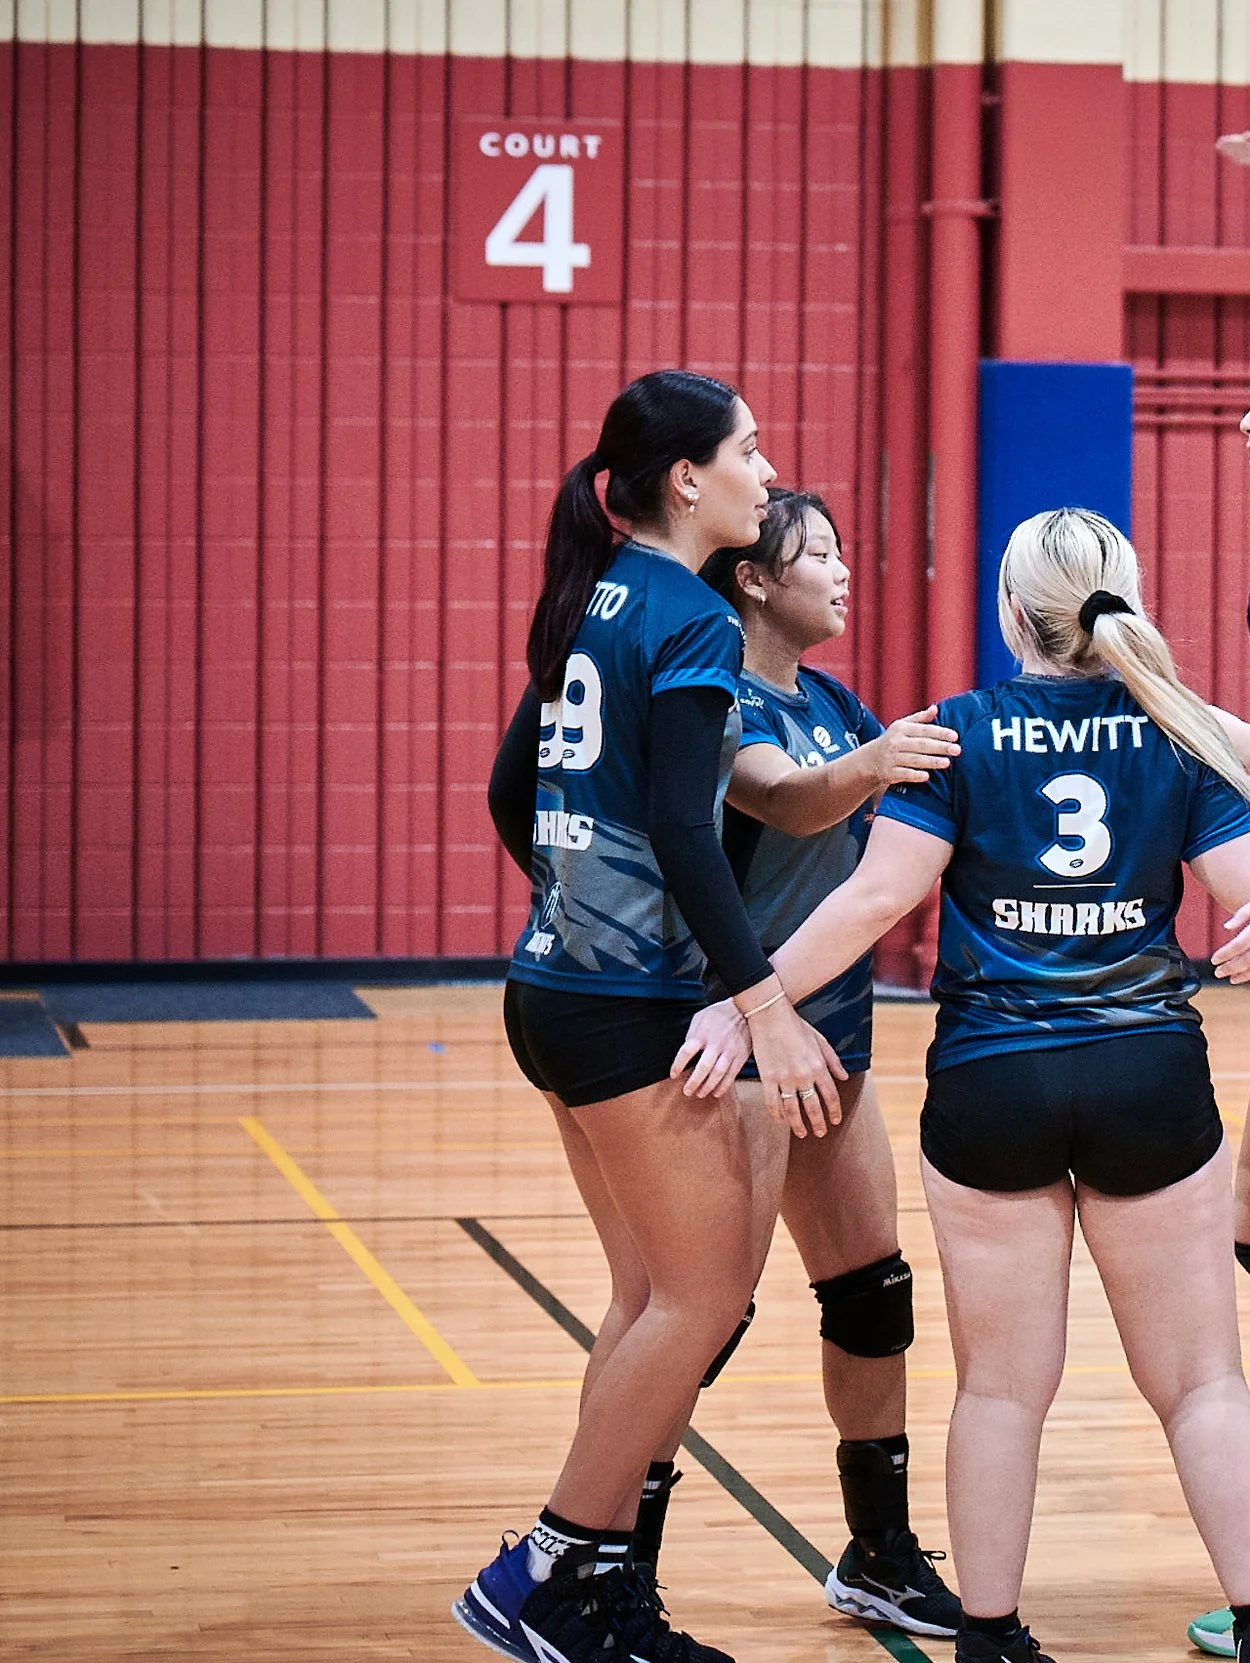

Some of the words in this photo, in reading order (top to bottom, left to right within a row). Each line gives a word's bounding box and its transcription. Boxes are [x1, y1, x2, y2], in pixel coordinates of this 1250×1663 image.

[479, 131, 602, 159] COURT
[485, 163, 592, 292] 4
[991, 714, 1149, 753] HEWITT
[1038, 773, 1113, 878] 3
[992, 898, 1147, 936] SHARKS
